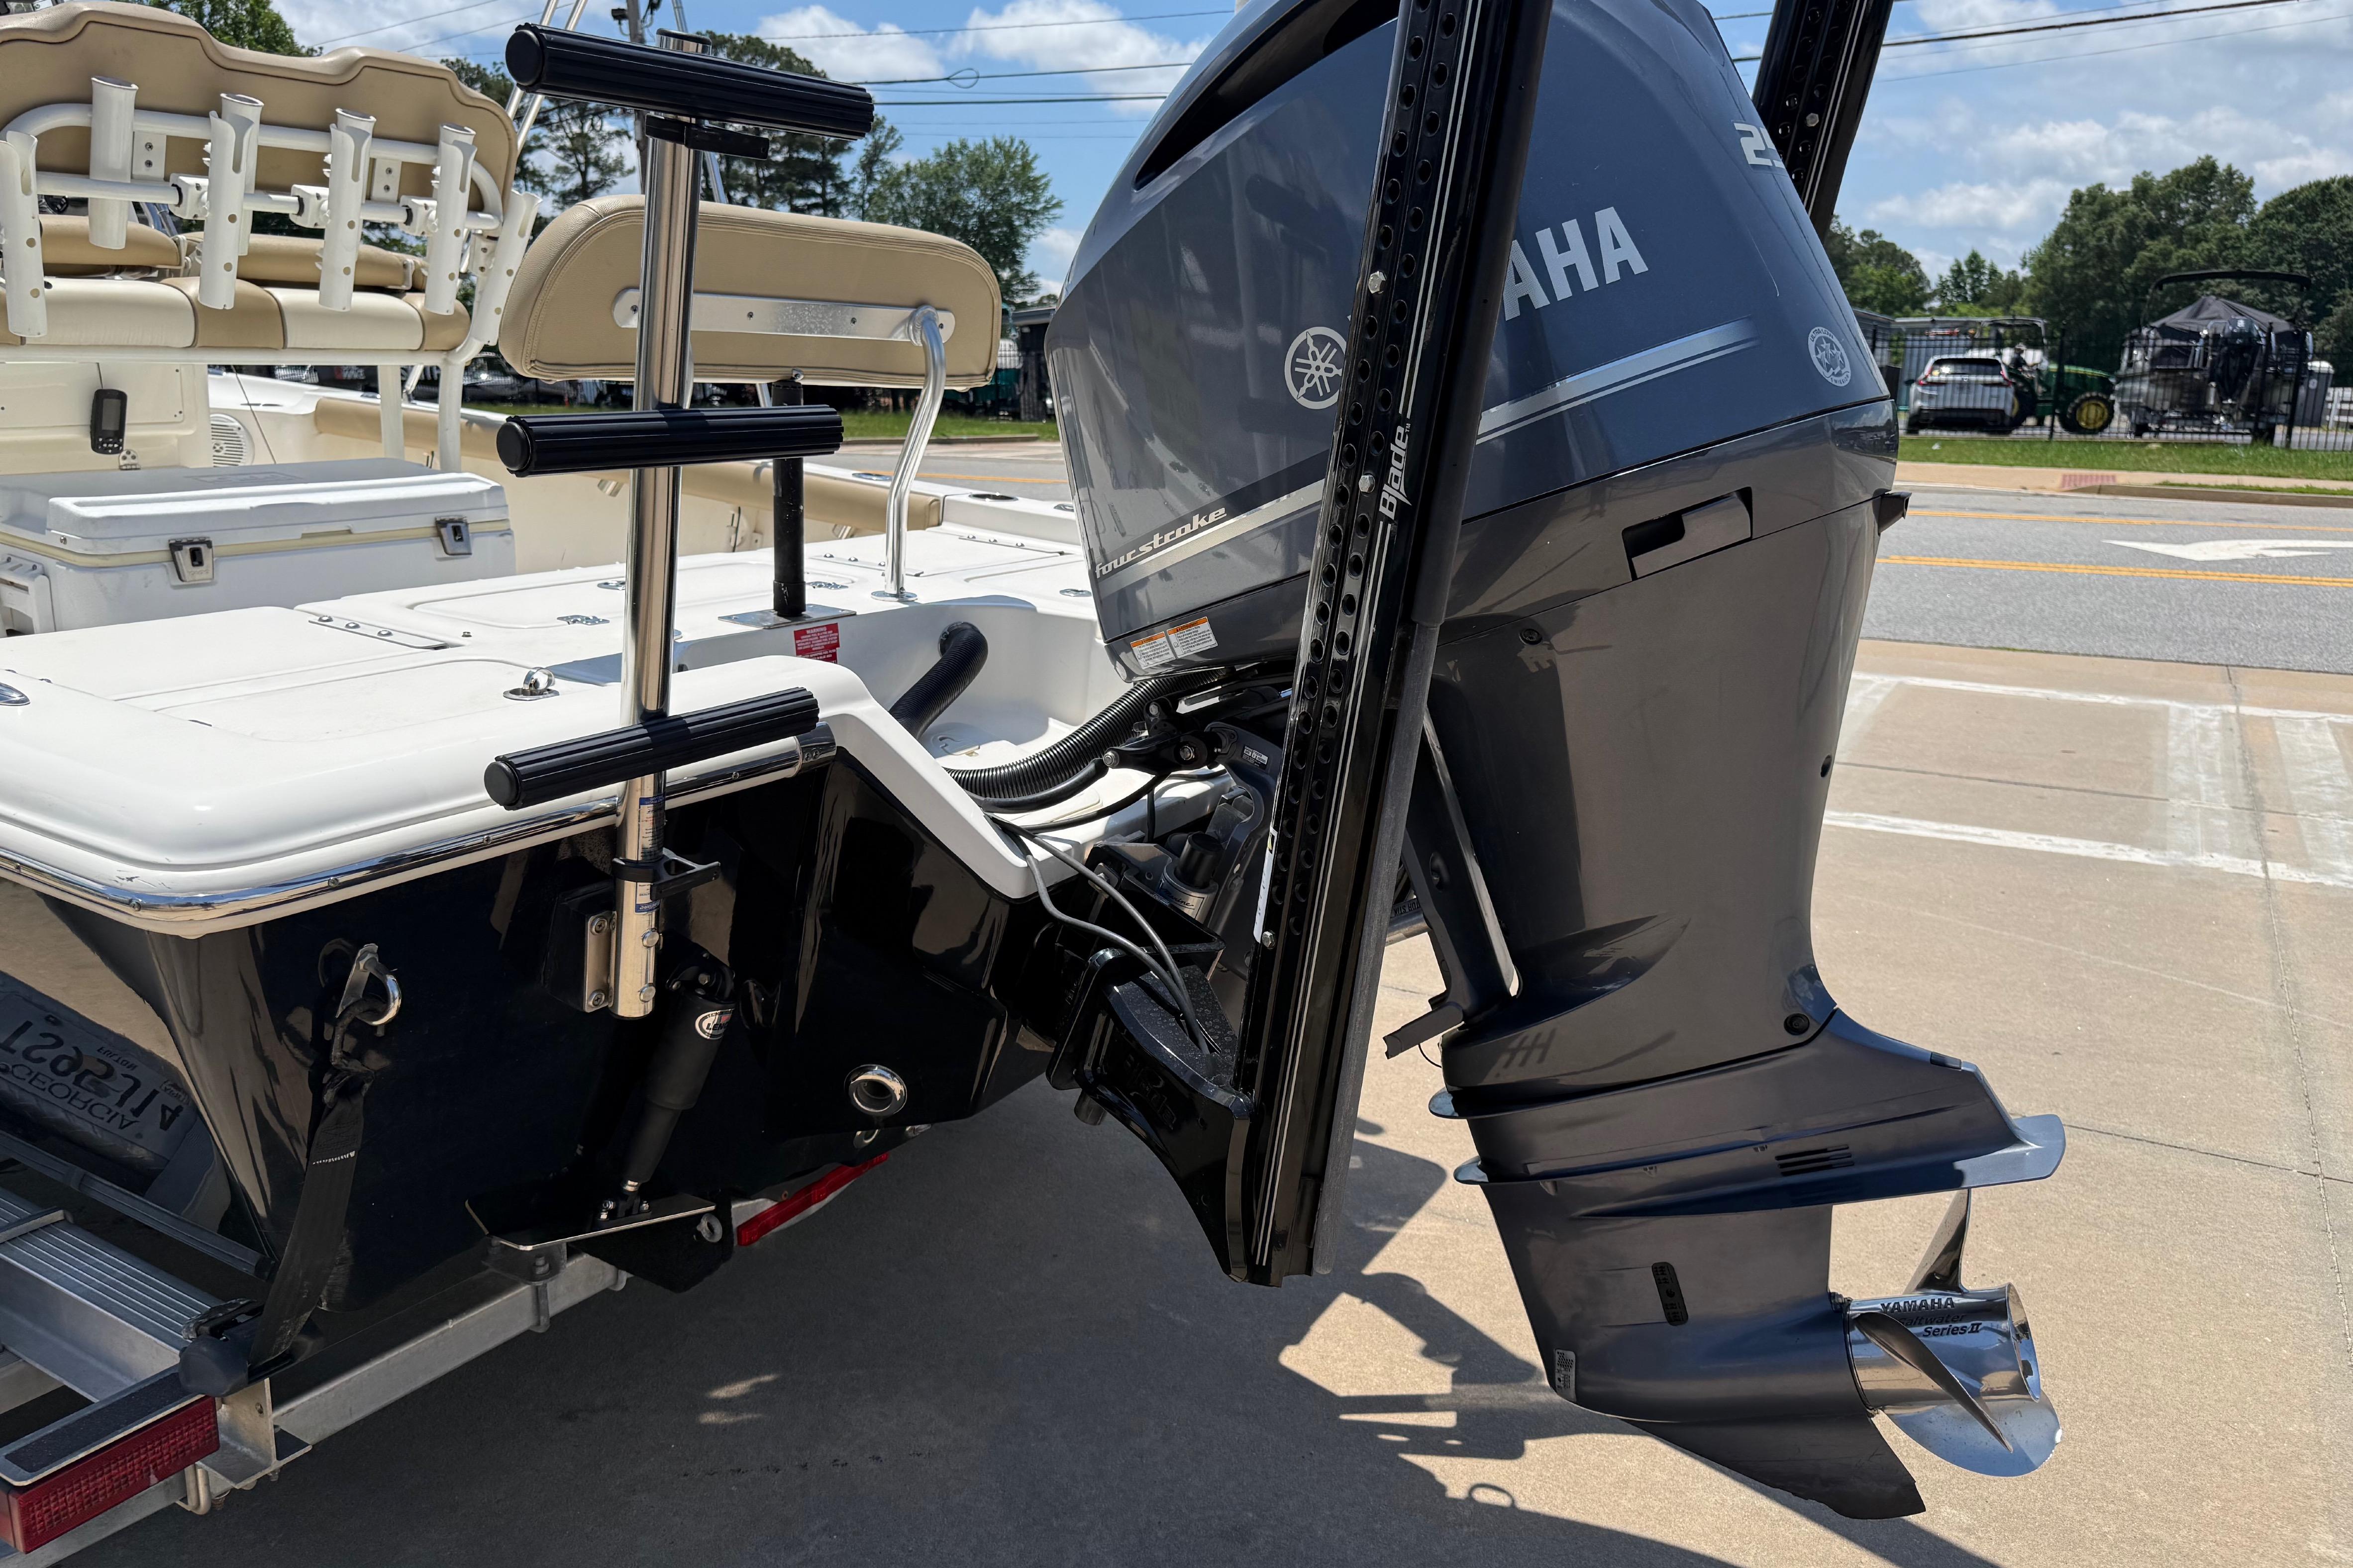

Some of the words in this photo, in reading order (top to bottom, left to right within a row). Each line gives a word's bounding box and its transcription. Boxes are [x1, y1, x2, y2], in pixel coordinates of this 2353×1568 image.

[1379, 425, 1412, 520] Blade
[1095, 549, 1136, 579] four
[1139, 507, 1227, 553] stroke
[1880, 1297, 1955, 1314] YAMAHA
[1922, 1324, 1967, 1337] Series
[1968, 1322, 1982, 1334] II
